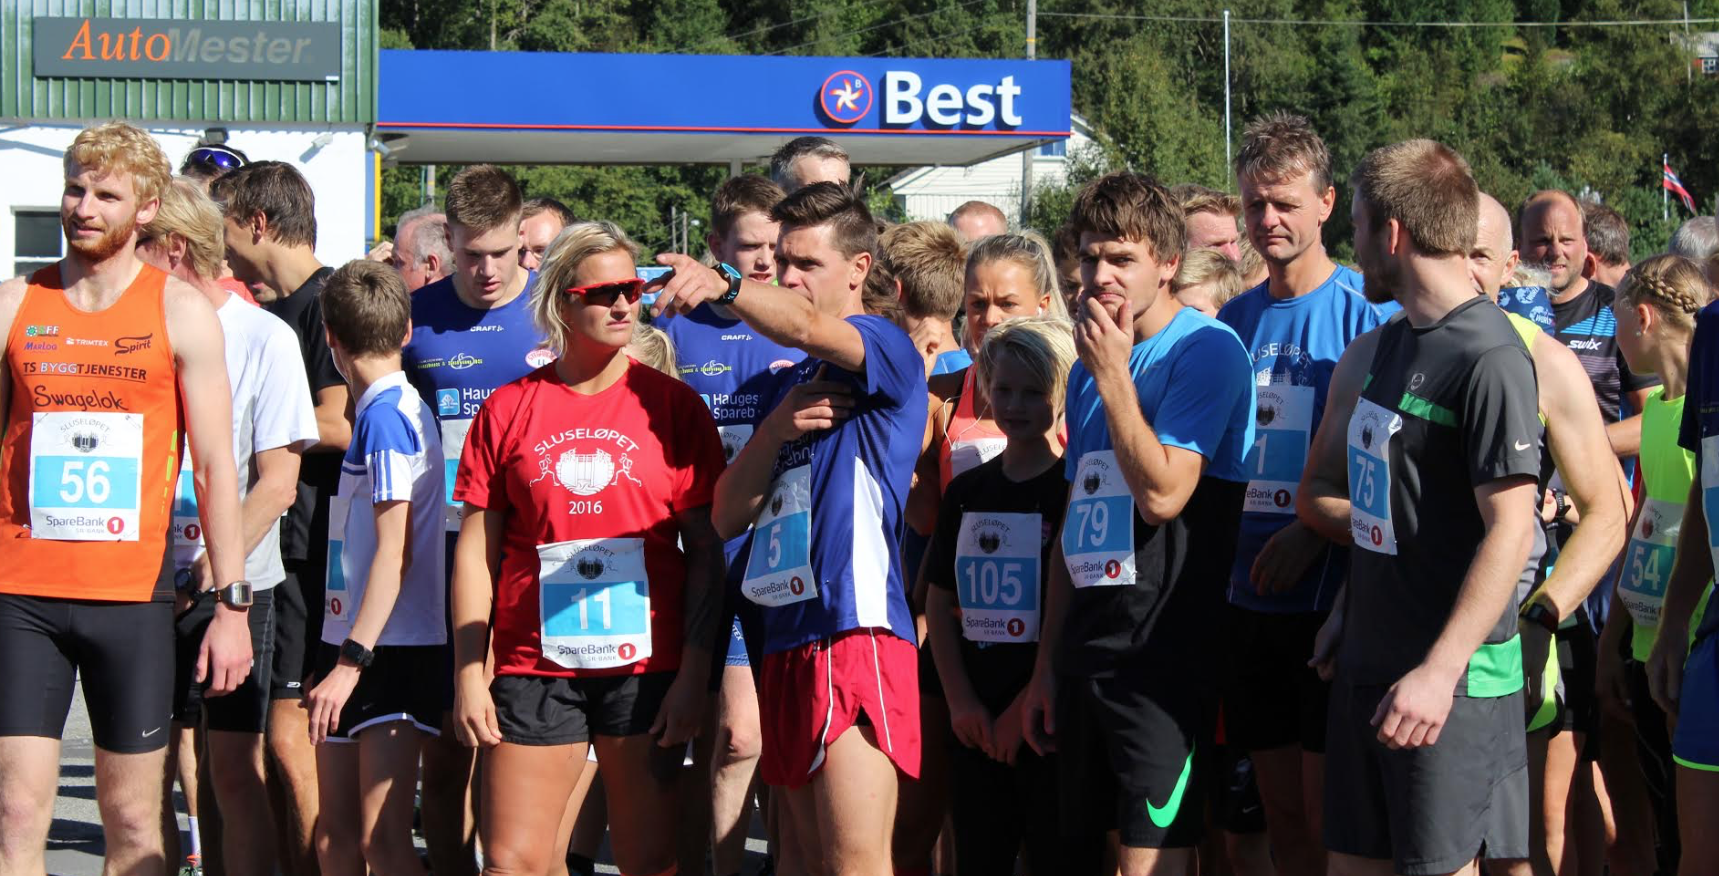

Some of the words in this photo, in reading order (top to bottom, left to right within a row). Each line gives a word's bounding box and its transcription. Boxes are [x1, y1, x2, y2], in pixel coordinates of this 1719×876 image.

[885, 70, 1022, 126] Best
[75, 338, 109, 347] TRIMTEX
[115, 333, 153, 356] Spirit
[1251, 342, 1312, 369] USELØPET
[23, 362, 36, 373] TS
[40, 362, 147, 380] BYGGTJENESTER
[34, 385, 129, 411] Swagelok
[60, 418, 110, 433] SLUSELØPET
[534, 428, 640, 456] SLUSELØPET
[1254, 433, 1268, 475] 1
[60, 460, 110, 504] 56
[1356, 454, 1375, 508] 75
[1246, 488, 1273, 499] eBank
[568, 500, 603, 515] 2016
[46, 515, 105, 527] SpareBank
[1076, 500, 1109, 549] 79
[566, 545, 616, 560] SLUSELØPET
[768, 523, 781, 569] 5
[1070, 560, 1104, 575] SpareBank
[1631, 545, 1661, 591] 54
[751, 580, 789, 598] SpareBank
[966, 560, 1023, 606] 105
[571, 587, 611, 630] 11
[966, 616, 1006, 629] SpareBank
[557, 644, 616, 656] SpareBank
